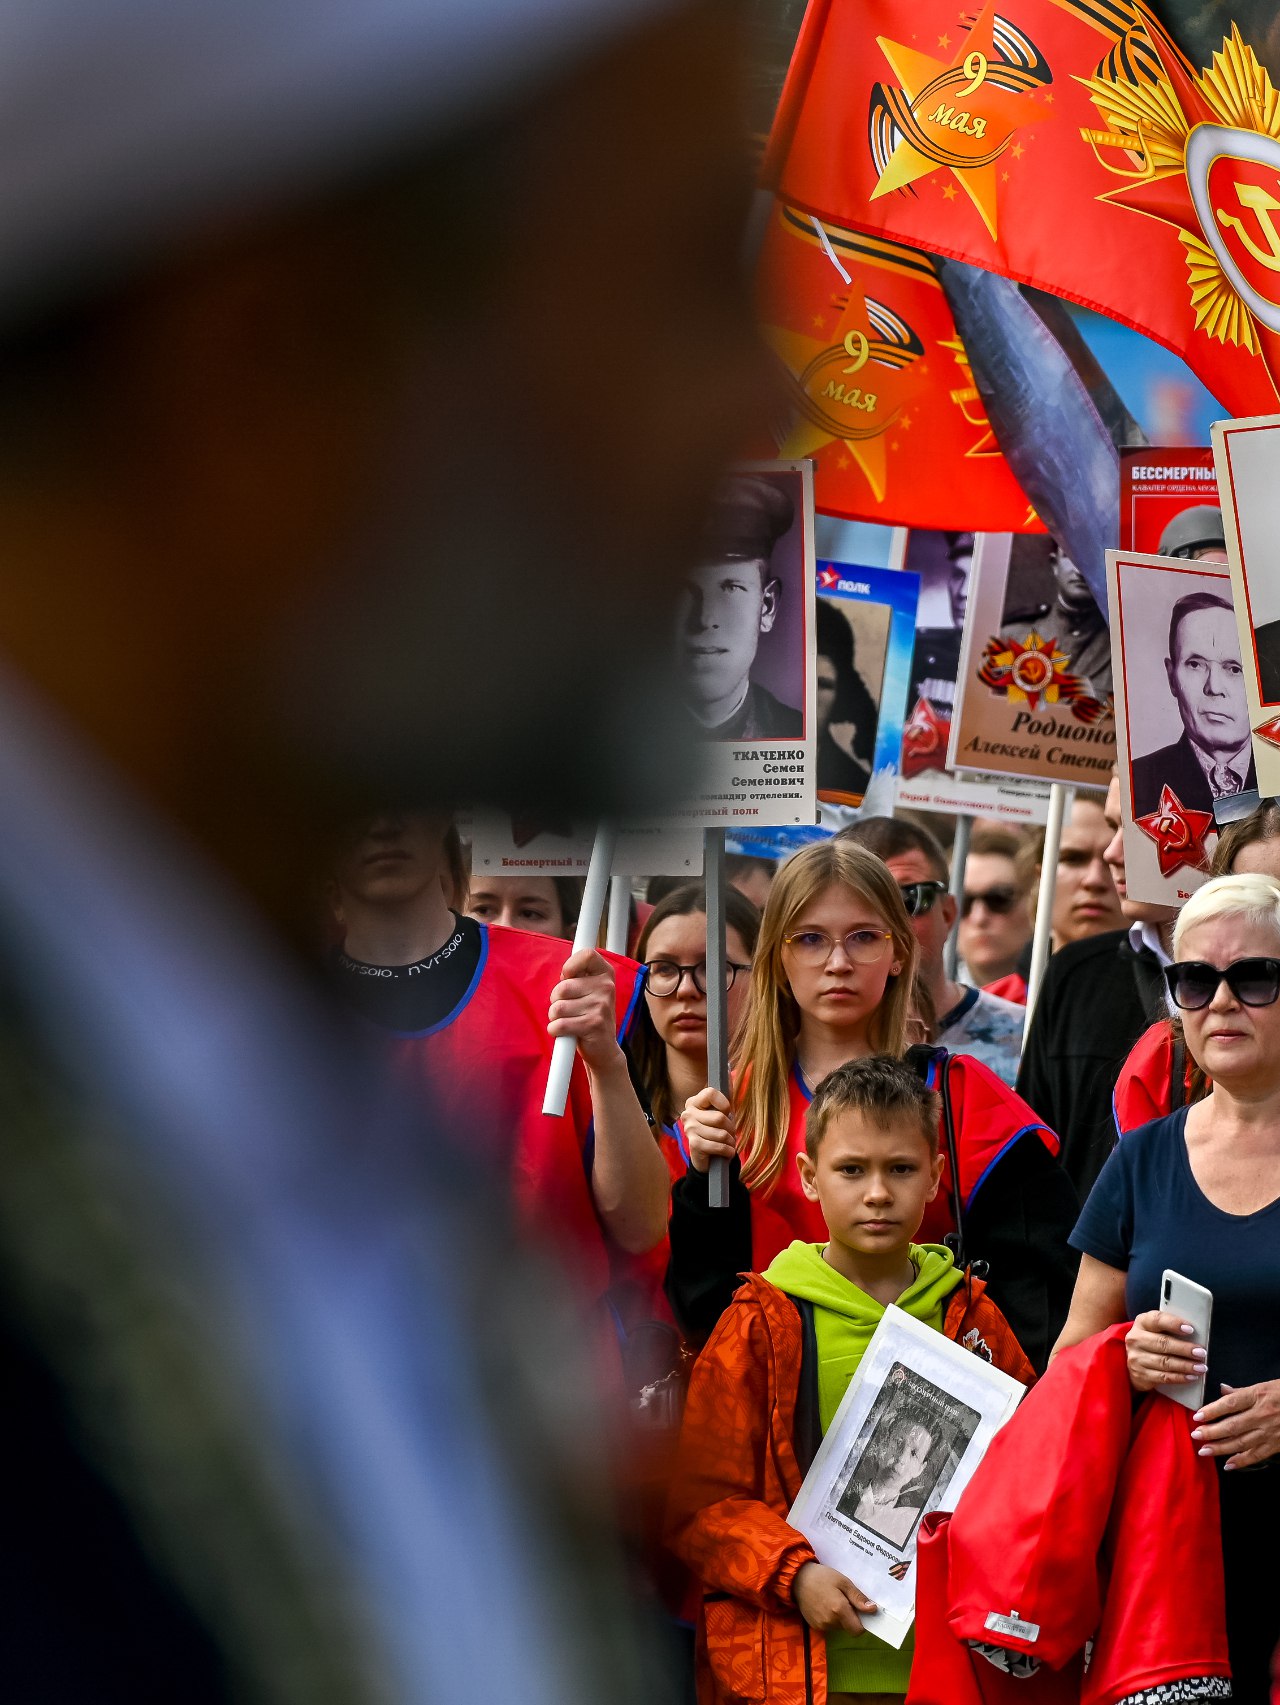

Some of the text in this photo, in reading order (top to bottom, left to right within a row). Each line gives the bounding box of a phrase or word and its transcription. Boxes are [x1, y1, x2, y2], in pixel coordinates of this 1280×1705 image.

[954, 51, 988, 98] 9
[927, 103, 988, 139] мая
[842, 329, 869, 374] 9
[821, 380, 878, 412] мая
[1131, 466, 1217, 480] БЕССМЕРТНЫ
[1010, 711, 1116, 745] Родионо
[732, 750, 805, 761] ТКАЧЕНКО
[762, 763, 805, 773] Семен
[964, 735, 1116, 771] Алексей Степан
[731, 777, 805, 787] Семенович
[749, 791, 803, 799] отделения.
[501, 857, 573, 868] Бессмертный
[408, 932, 465, 976] nvrsolo.
